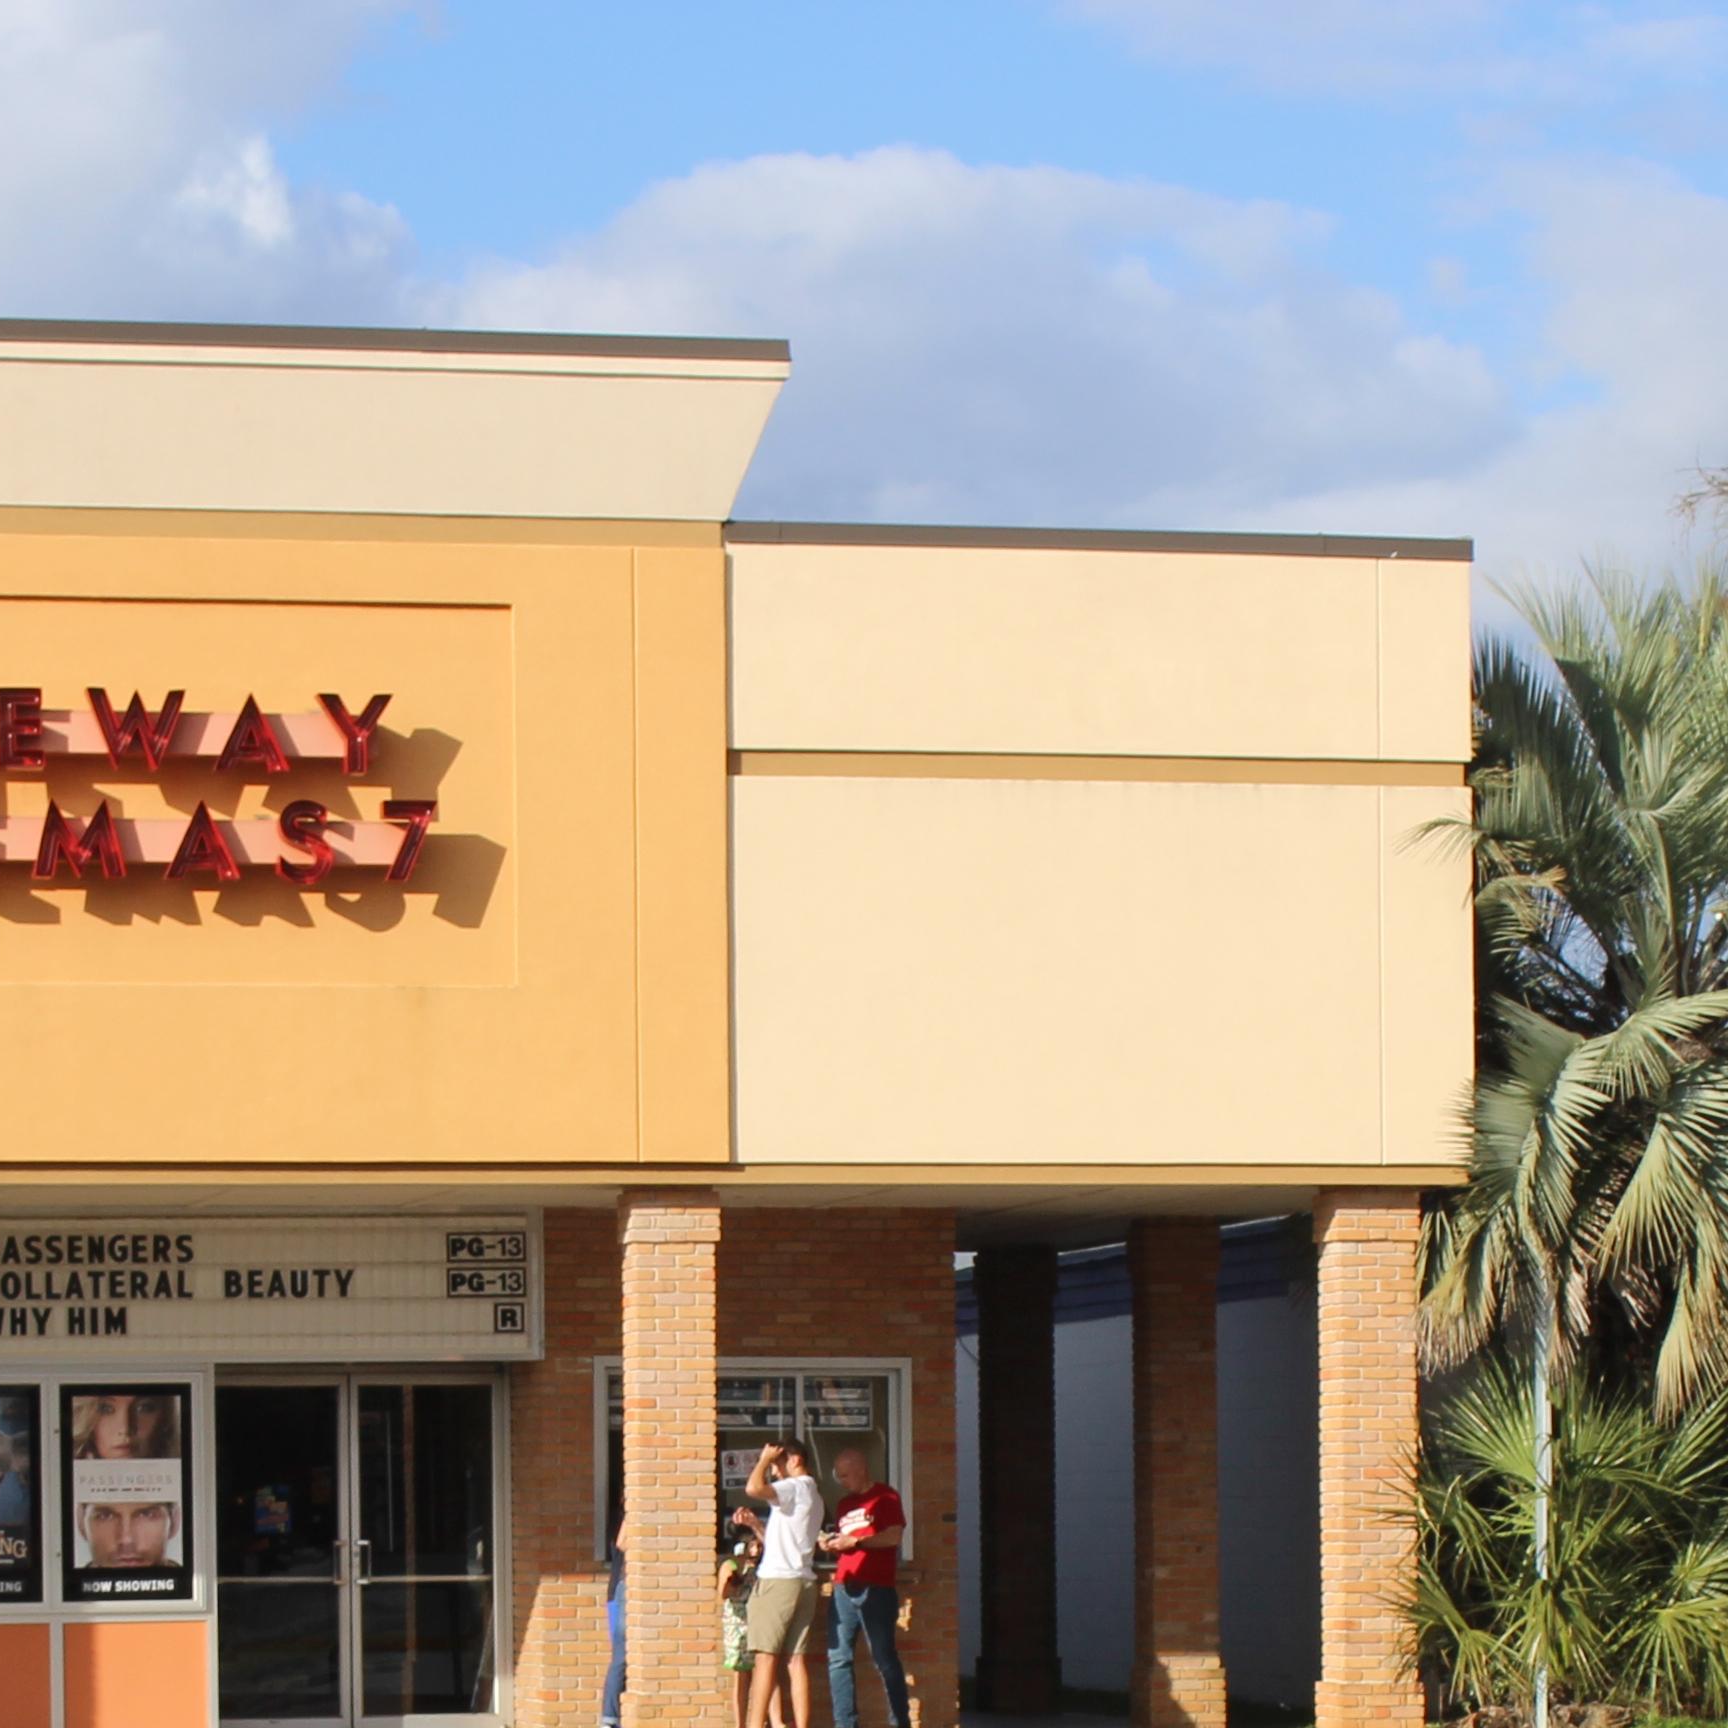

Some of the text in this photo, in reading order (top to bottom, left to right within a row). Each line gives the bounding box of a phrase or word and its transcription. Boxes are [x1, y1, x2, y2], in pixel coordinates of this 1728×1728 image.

[449, 1236, 522, 1258] PG-13
[224, 1269, 354, 1298] BEAUTY
[450, 1272, 522, 1293] PG-13
[67, 1306, 127, 1336] HIM
[499, 1307, 518, 1328] R
[82, 1579, 174, 1592] NOW SHOWING
